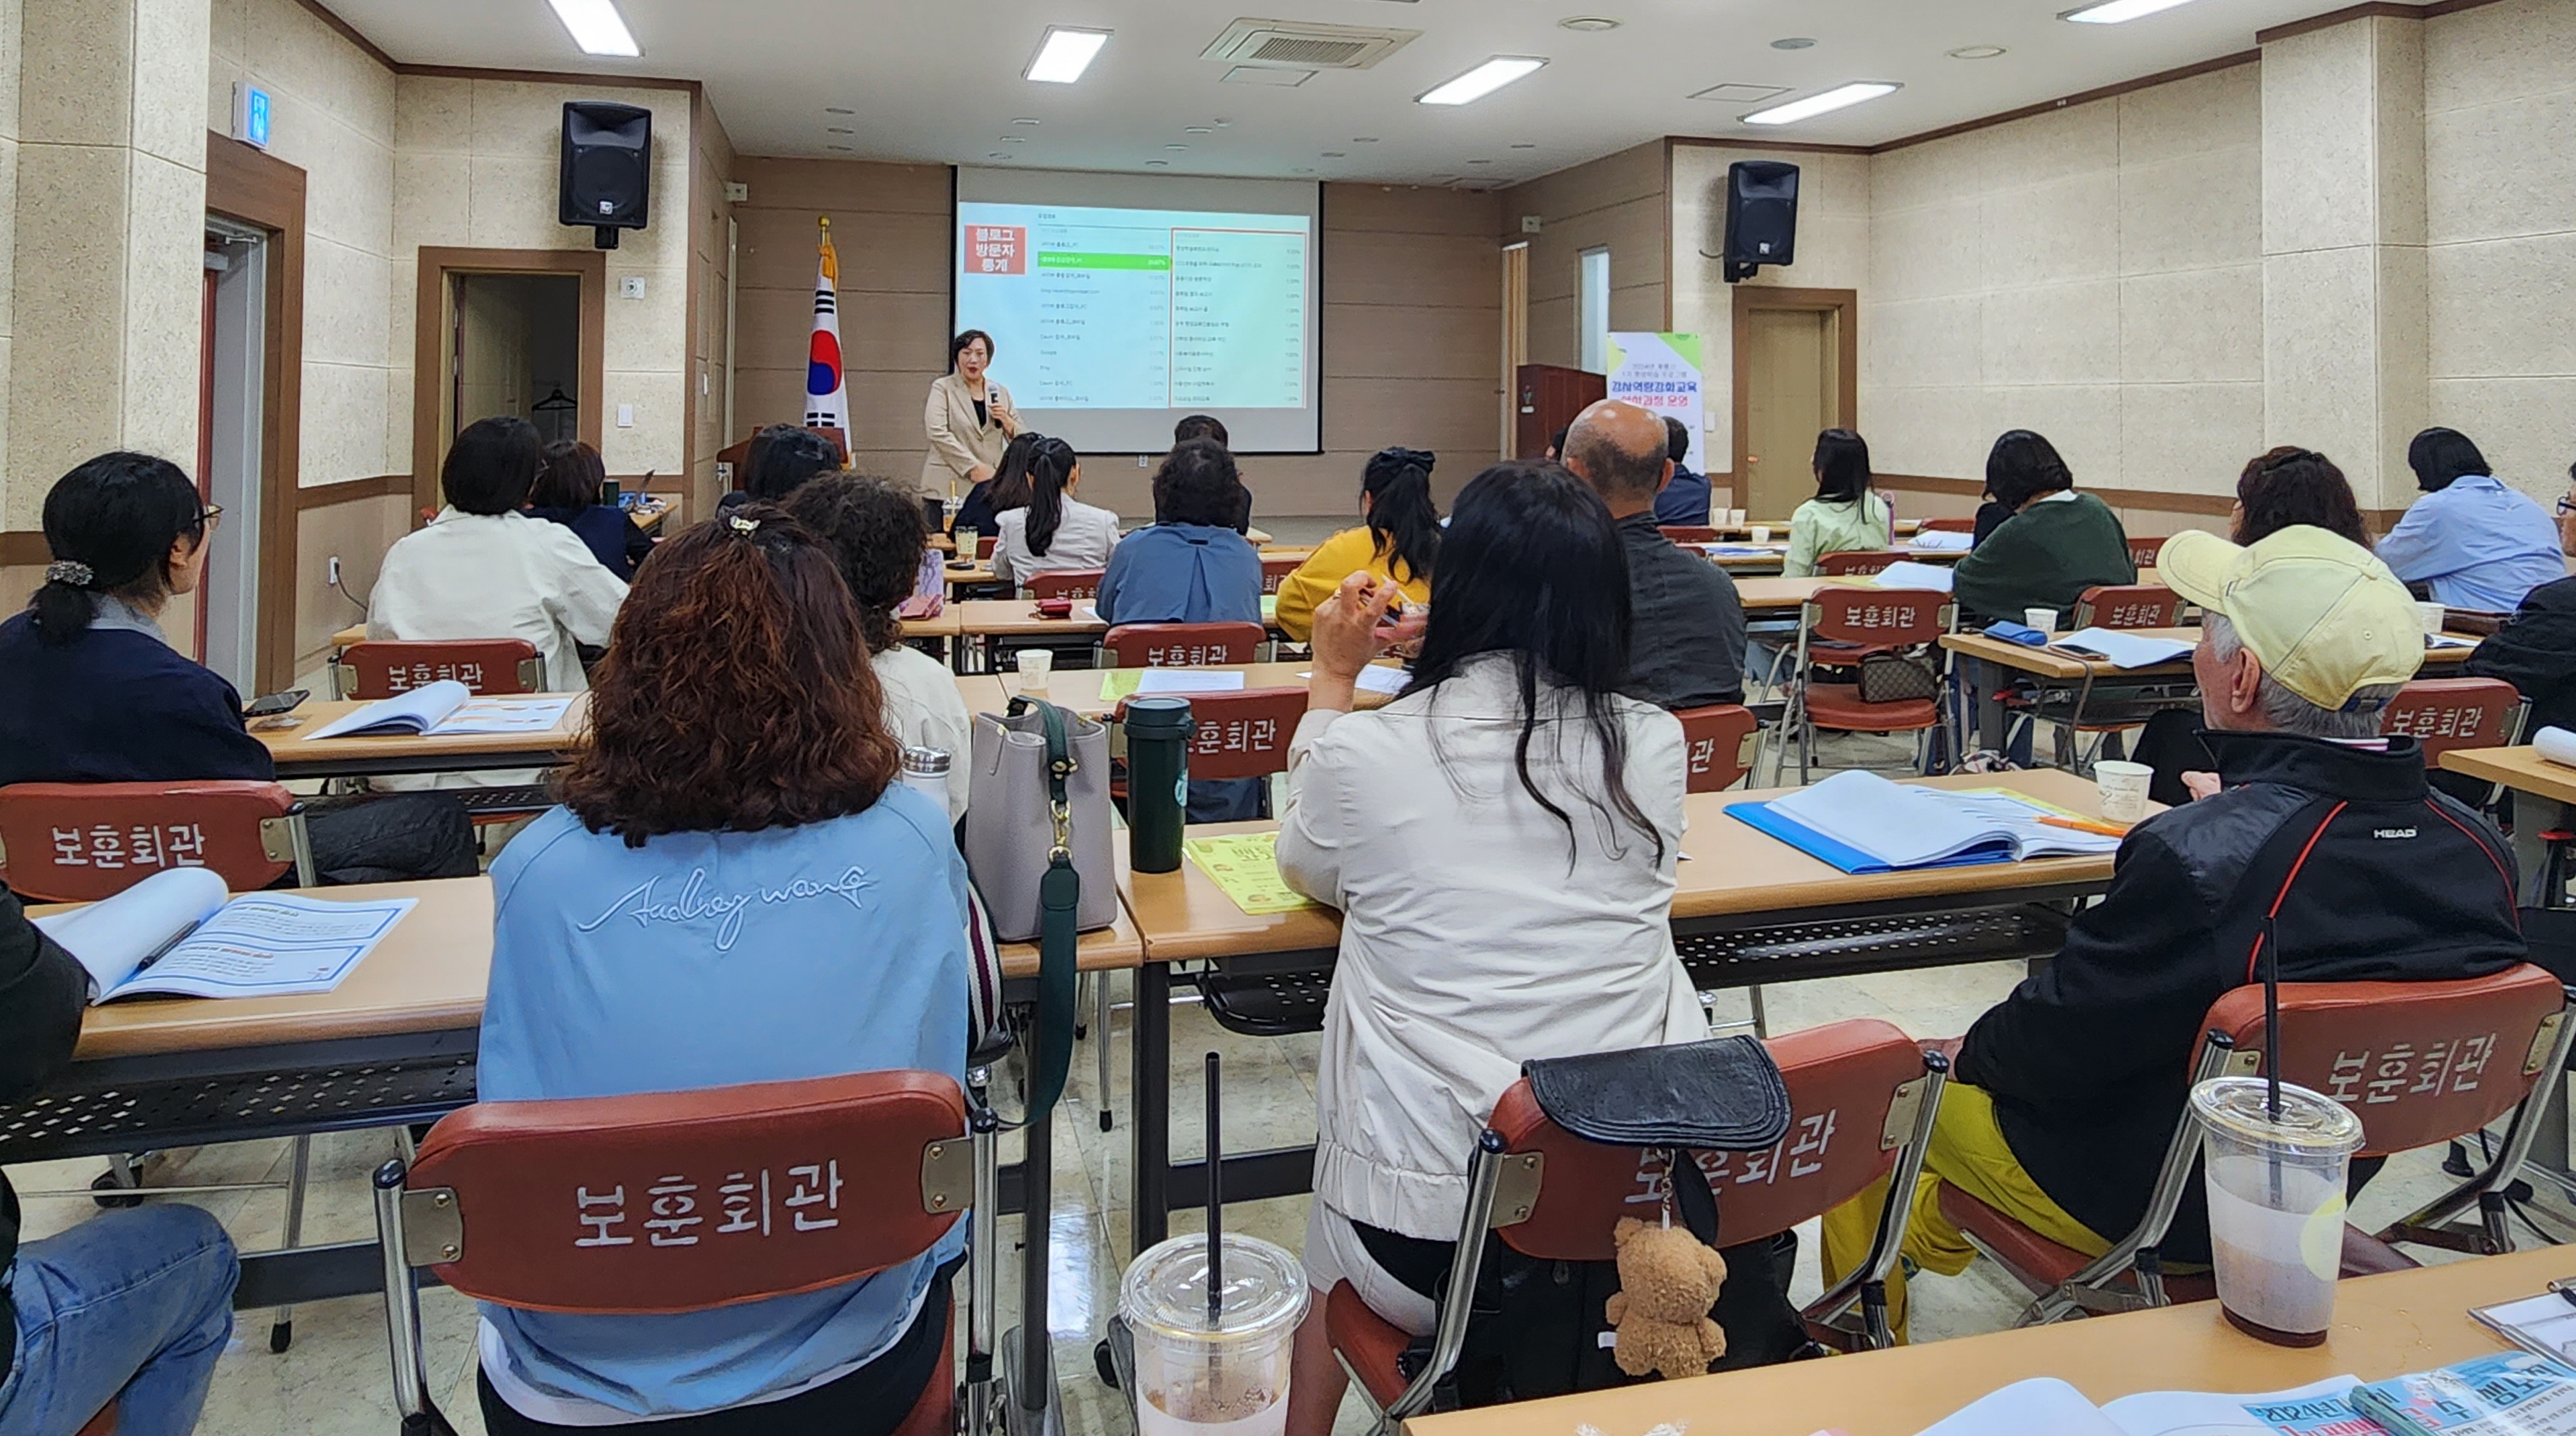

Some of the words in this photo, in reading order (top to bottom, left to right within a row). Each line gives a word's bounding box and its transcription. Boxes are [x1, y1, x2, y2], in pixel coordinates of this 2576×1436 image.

[976, 243, 1014, 258] 방문자
[1843, 605, 1916, 628] 보훈회관
[2109, 604, 2162, 627] 보훈회관
[1187, 718, 1277, 754] 훈회관
[2387, 706, 2483, 739] 보훈회관
[51, 823, 205, 869] 보훈회관
[2373, 828, 2417, 839] HEAD
[2328, 1032, 2497, 1104] 보훈회관
[574, 1159, 844, 1247] 보훈회관
[2264, 1399, 2343, 1422] 2024년
